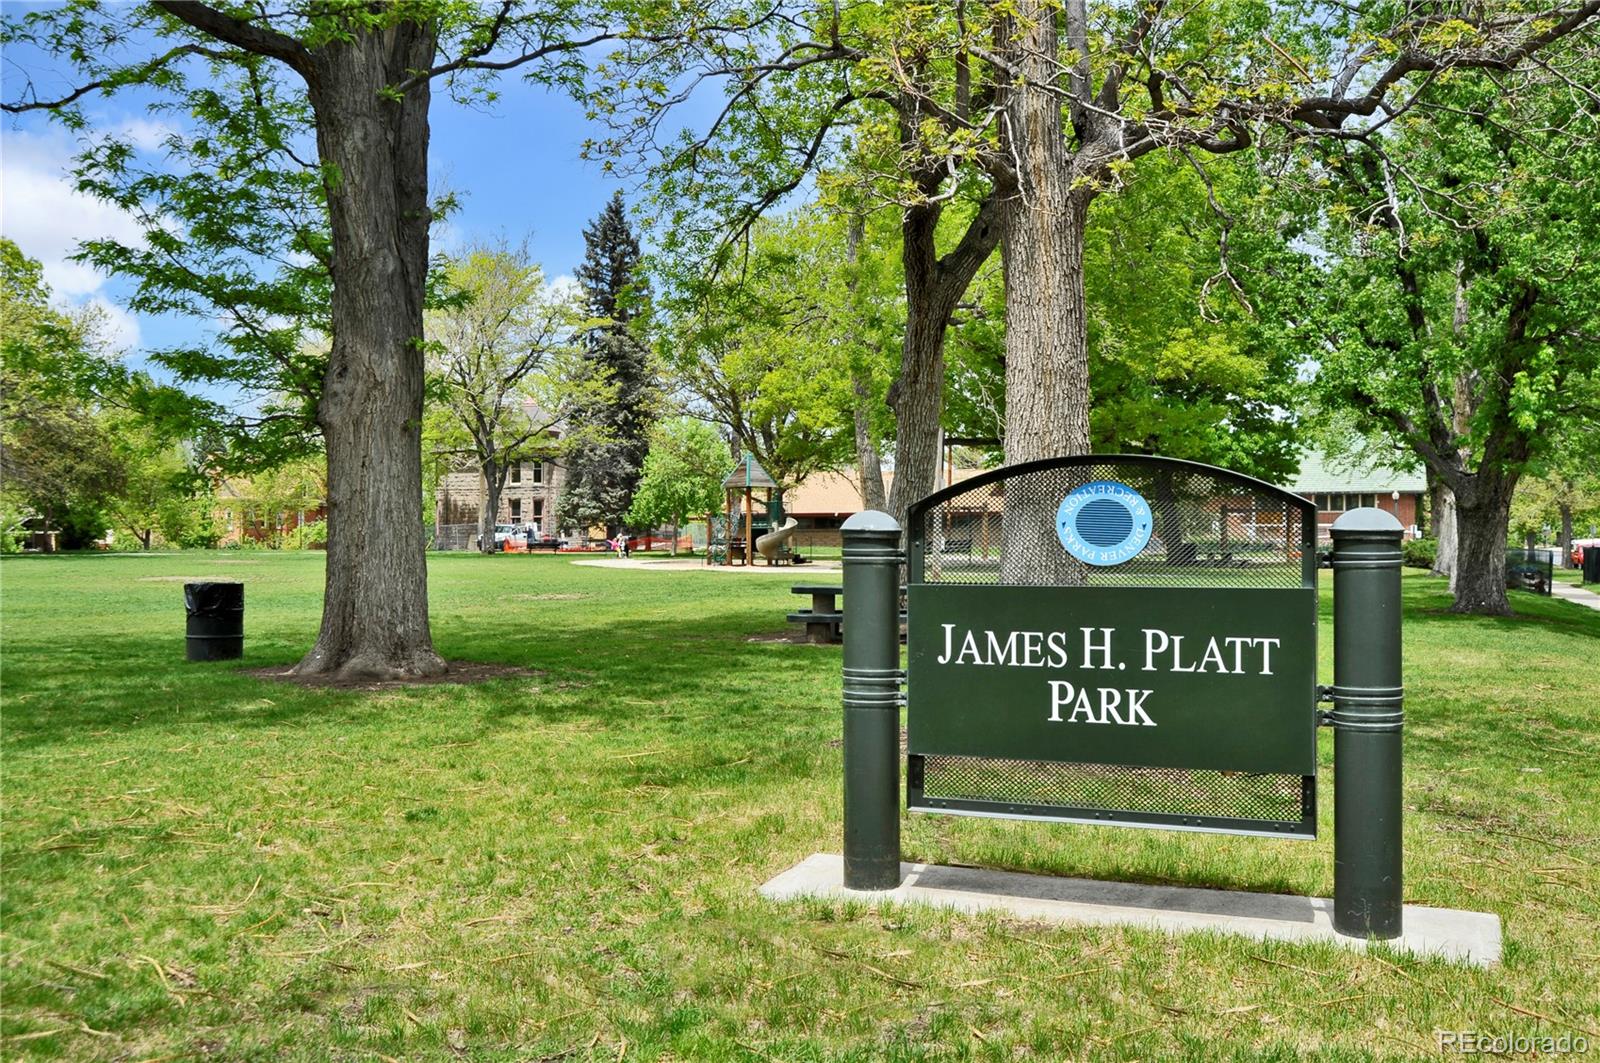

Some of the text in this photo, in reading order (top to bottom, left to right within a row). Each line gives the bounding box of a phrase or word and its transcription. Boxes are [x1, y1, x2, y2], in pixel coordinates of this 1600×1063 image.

[1064, 484, 1146, 517] & RECREATION
[1063, 526, 1145, 561] DENVER PARKS
[937, 623, 1281, 675] JAMES H. PLATT
[1047, 680, 1158, 727] PARK
